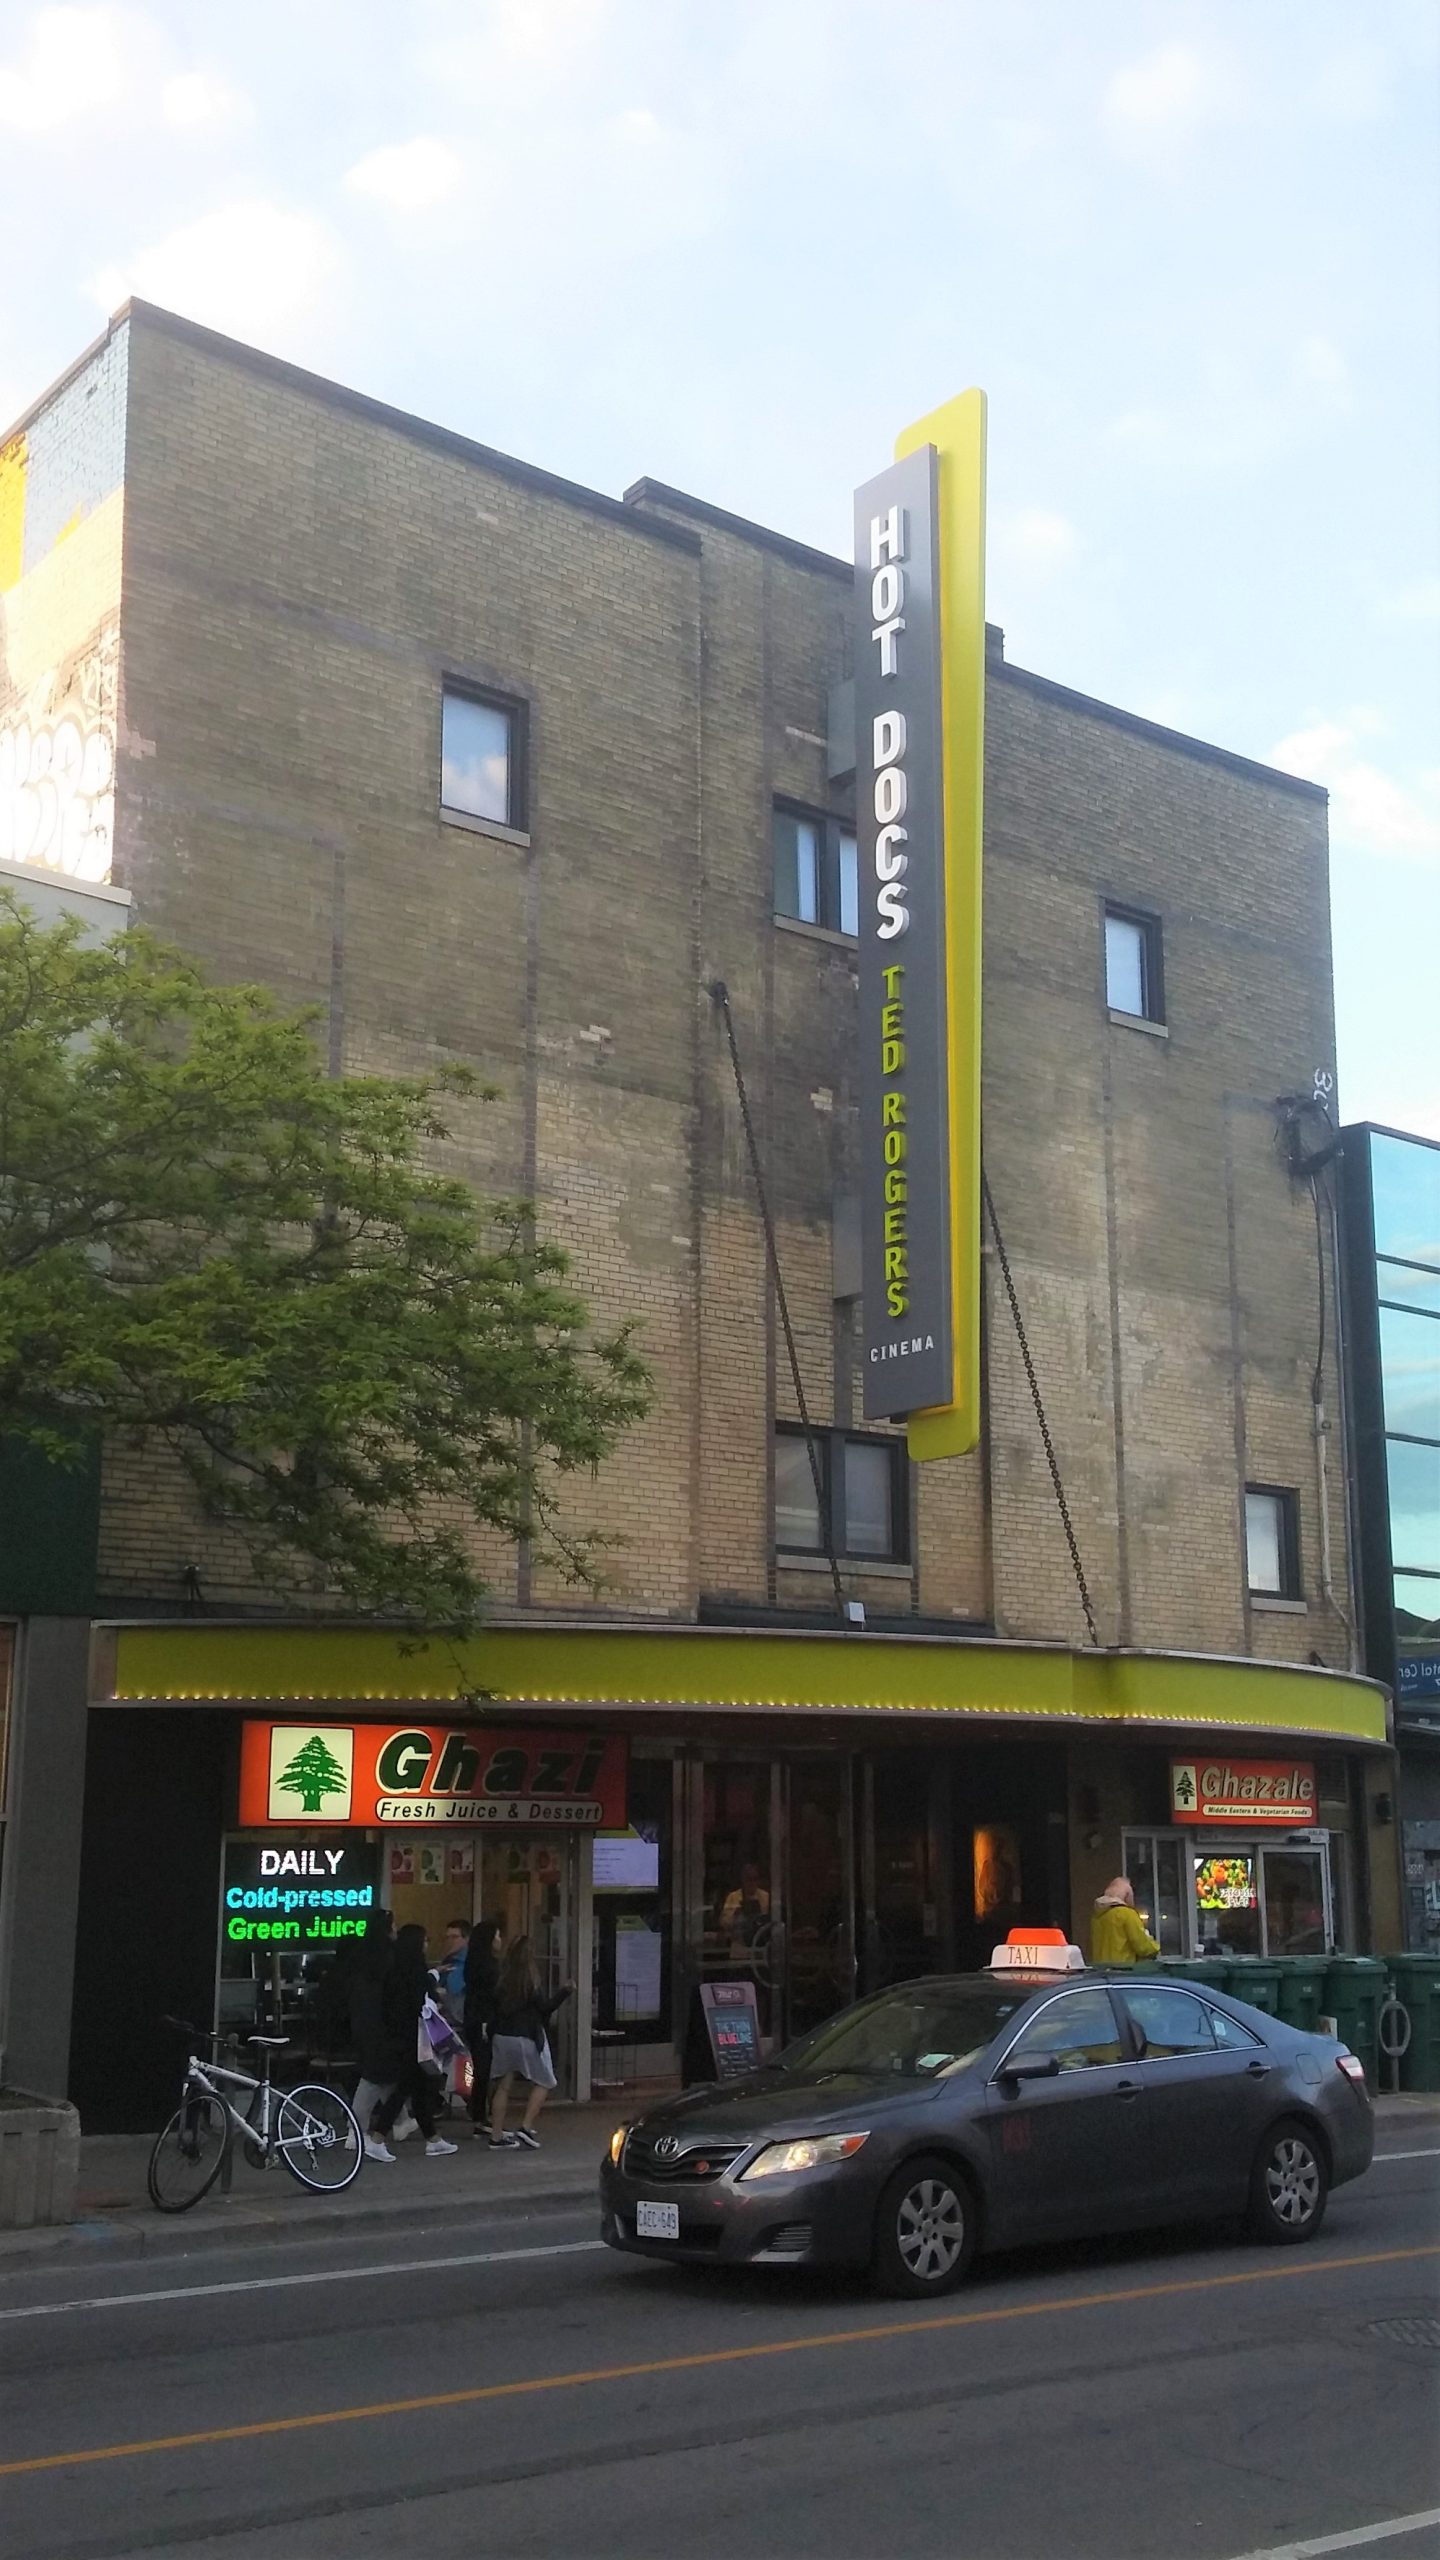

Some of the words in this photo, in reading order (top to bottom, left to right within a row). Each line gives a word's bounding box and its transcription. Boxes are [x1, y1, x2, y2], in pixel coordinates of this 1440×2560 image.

[870, 504, 907, 677] HOT
[872, 709, 909, 940] DOCS
[881, 964, 905, 1075] TED
[882, 1092, 908, 1318] ROGERS
[870, 1335, 934, 1362] CINEMA
[375, 1728, 603, 1796] Ghazi
[1201, 1766, 1314, 1800] Ghazale
[380, 1802, 436, 1818] Fresh
[445, 1802, 497, 1818] Juice
[508, 1803, 519, 1818] &
[529, 1803, 600, 1819] Dessert
[1208, 1806, 1227, 1814] Middle
[1260, 1808, 1289, 1816] Vegetarian
[261, 1850, 344, 1875] DAILY
[226, 1885, 373, 1913] Cold-pressed
[228, 1917, 300, 1940] Green
[306, 1916, 367, 1937] Juice
[1008, 1947, 1038, 1964] TAXI
